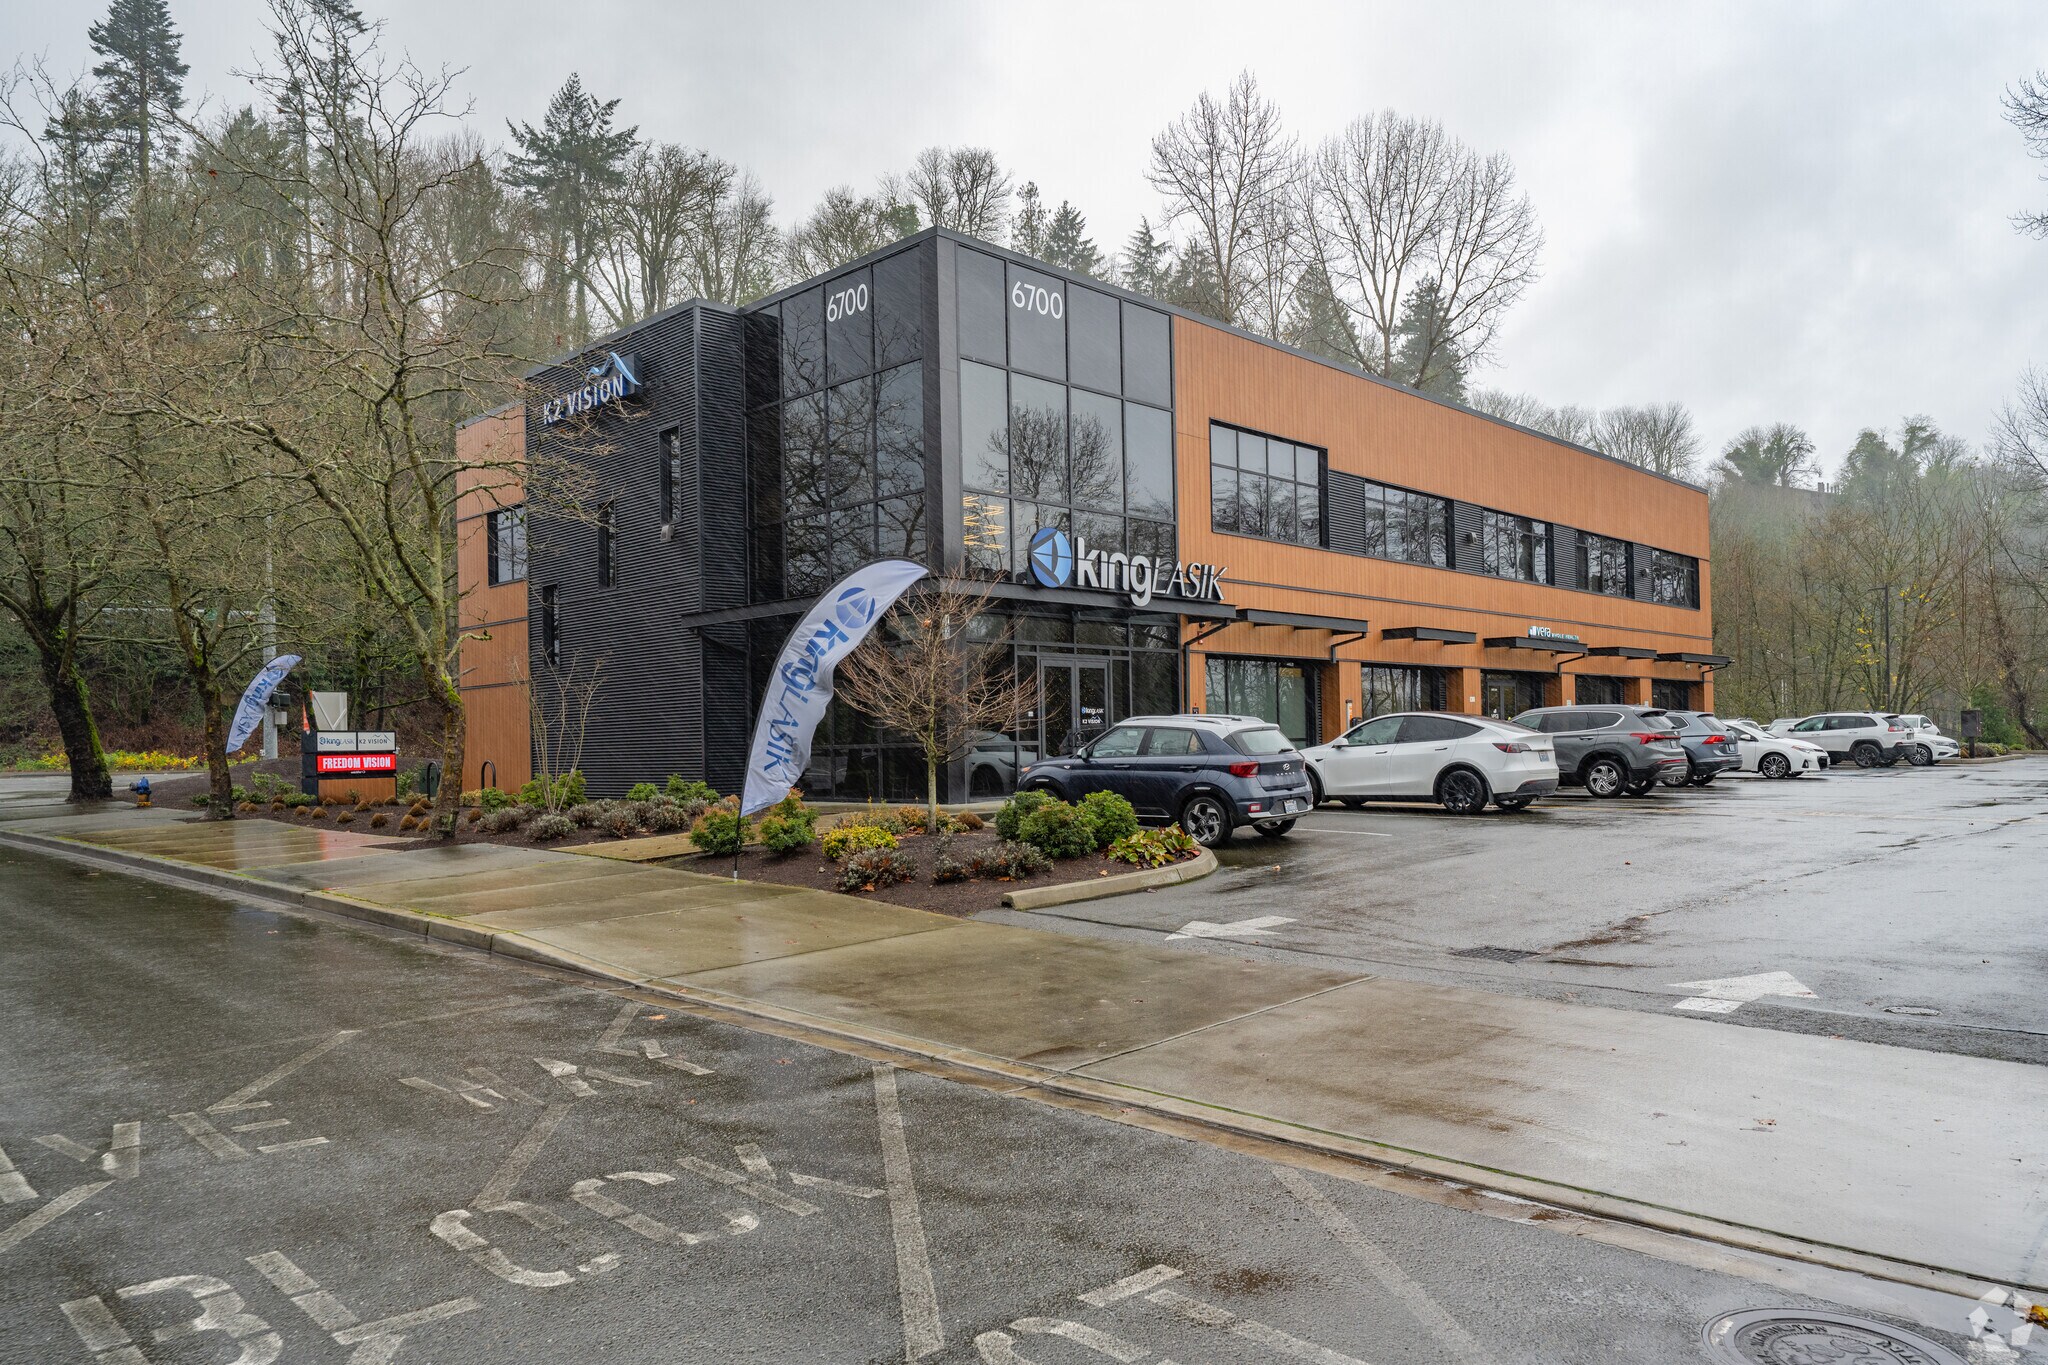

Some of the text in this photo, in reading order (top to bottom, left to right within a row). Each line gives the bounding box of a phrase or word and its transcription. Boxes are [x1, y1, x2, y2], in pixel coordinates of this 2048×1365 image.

[827, 283, 868, 322] 6700
[1012, 281, 1063, 319] 6700
[544, 374, 624, 424] K2 VISION
[322, 756, 391, 769] FREEDOM VISION
[60, 1142, 886, 1365] BLOCK
